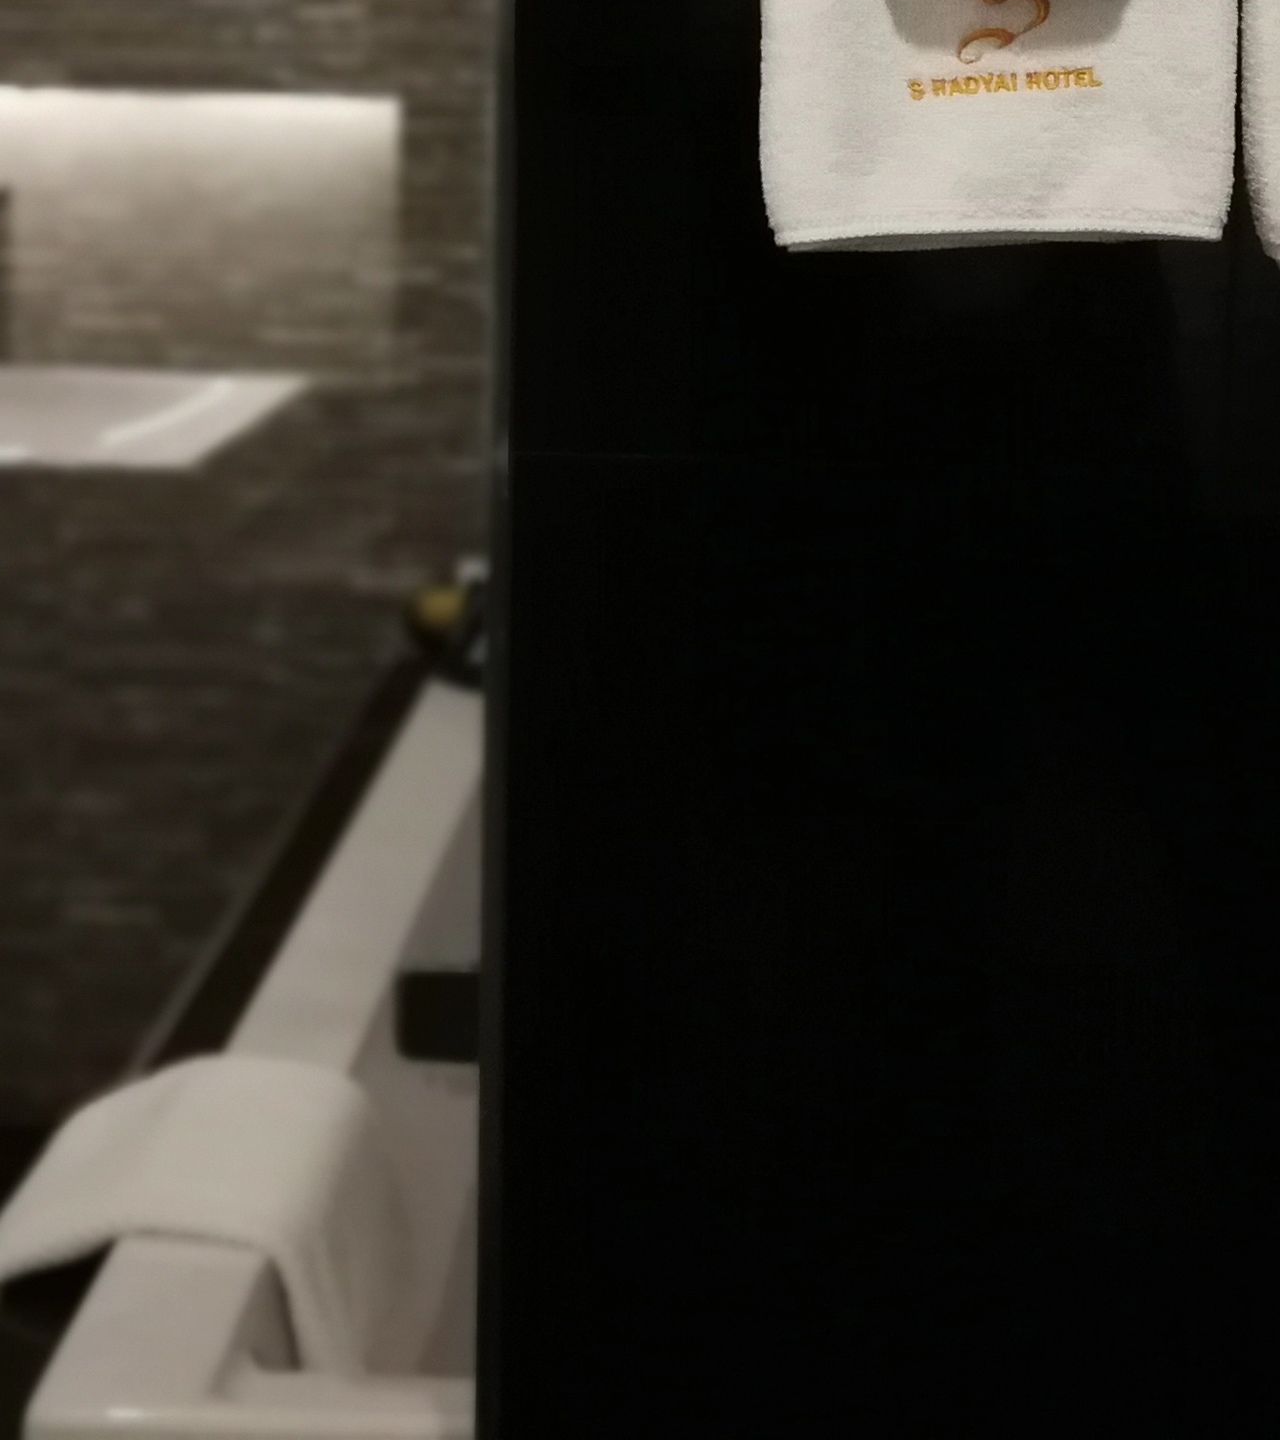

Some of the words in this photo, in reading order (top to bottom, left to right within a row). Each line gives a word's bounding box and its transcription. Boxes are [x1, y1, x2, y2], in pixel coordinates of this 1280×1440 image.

[907, 78, 926, 101] S
[931, 72, 1018, 97] HADYAI
[1025, 66, 1104, 91] HOTEL
